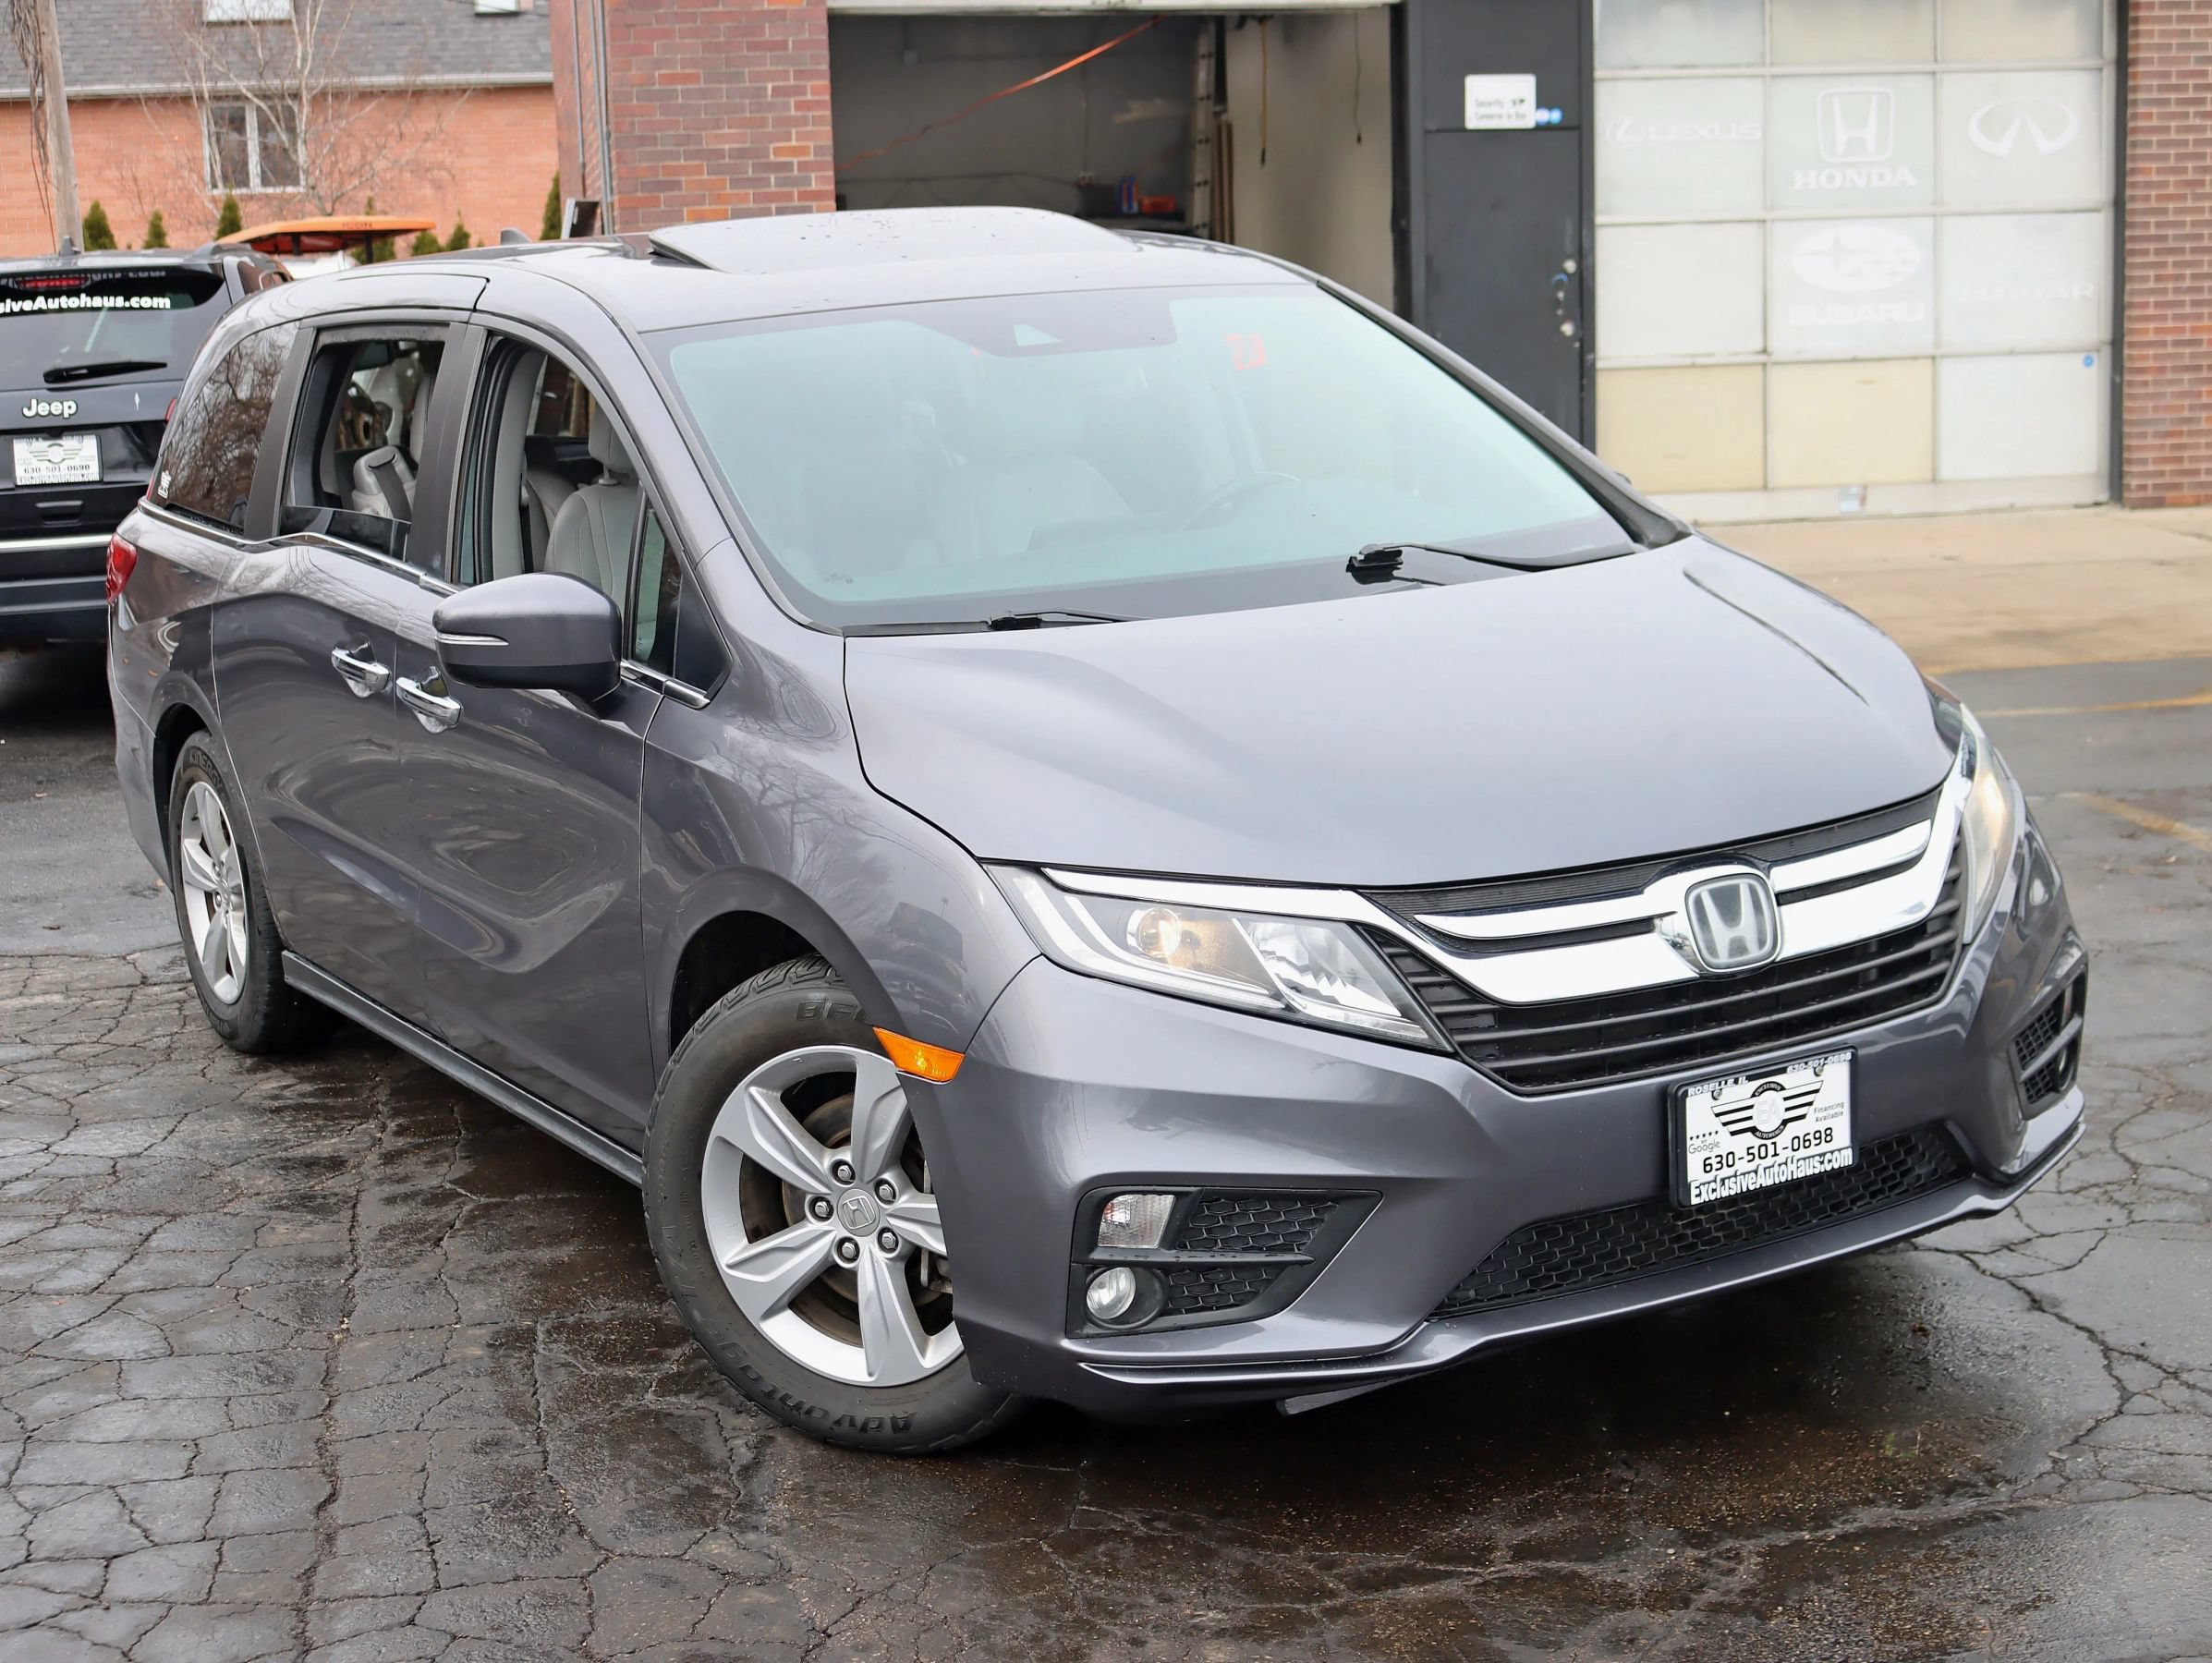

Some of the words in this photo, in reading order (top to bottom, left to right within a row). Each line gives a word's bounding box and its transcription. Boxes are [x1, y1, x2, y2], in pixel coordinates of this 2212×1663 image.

[1648, 121, 1762, 141] LEXUS
[1793, 166, 1917, 191] HONDA
[22, 398, 78, 419] Jeep
[1786, 1051, 1852, 1074] 630-501-0698
[1738, 1075, 1749, 1086] IL
[1688, 1139, 1720, 1155] Google
[1703, 1126, 1834, 1173] 630-501-0698
[1690, 1147, 1853, 1205] ExclusiveAutoHaus.com
